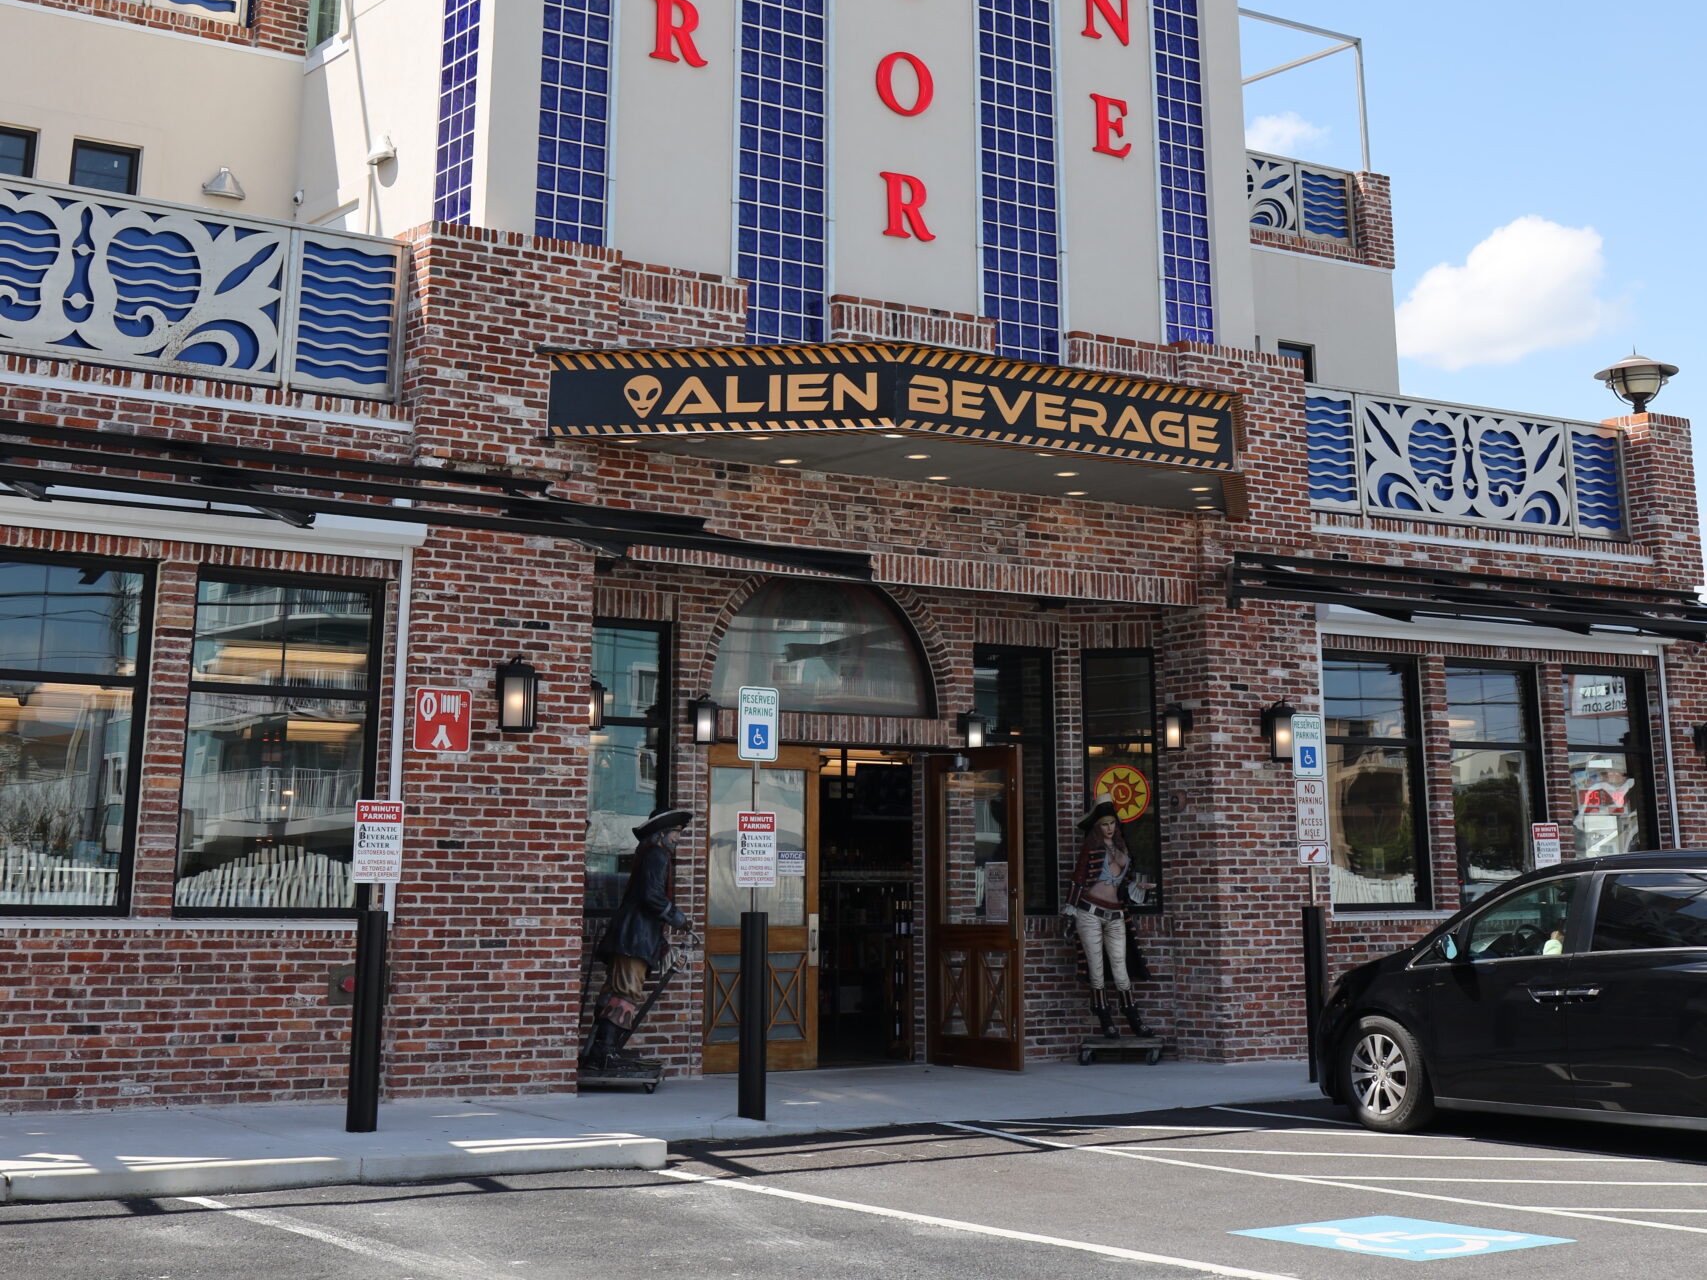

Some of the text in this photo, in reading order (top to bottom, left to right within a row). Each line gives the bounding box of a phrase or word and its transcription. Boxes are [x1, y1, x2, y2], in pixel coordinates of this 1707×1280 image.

[661, 372, 1220, 454] ALIEN BEVERAGE
[804, 502, 1025, 564] AREA 51
[742, 694, 776, 705] RESERVED
[744, 706, 773, 717] PARKING
[1293, 721, 1320, 730] RESERVED
[1296, 731, 1318, 740] PARKING
[1304, 784, 1316, 794] NO
[1299, 797, 1323, 805] PARKING
[1301, 818, 1323, 826] ACCESS
[359, 824, 398, 832] ATLANTIC
[359, 832, 399, 840] BEVERAGE
[1304, 829, 1320, 837] AISLE
[358, 840, 390, 848] CENTER
